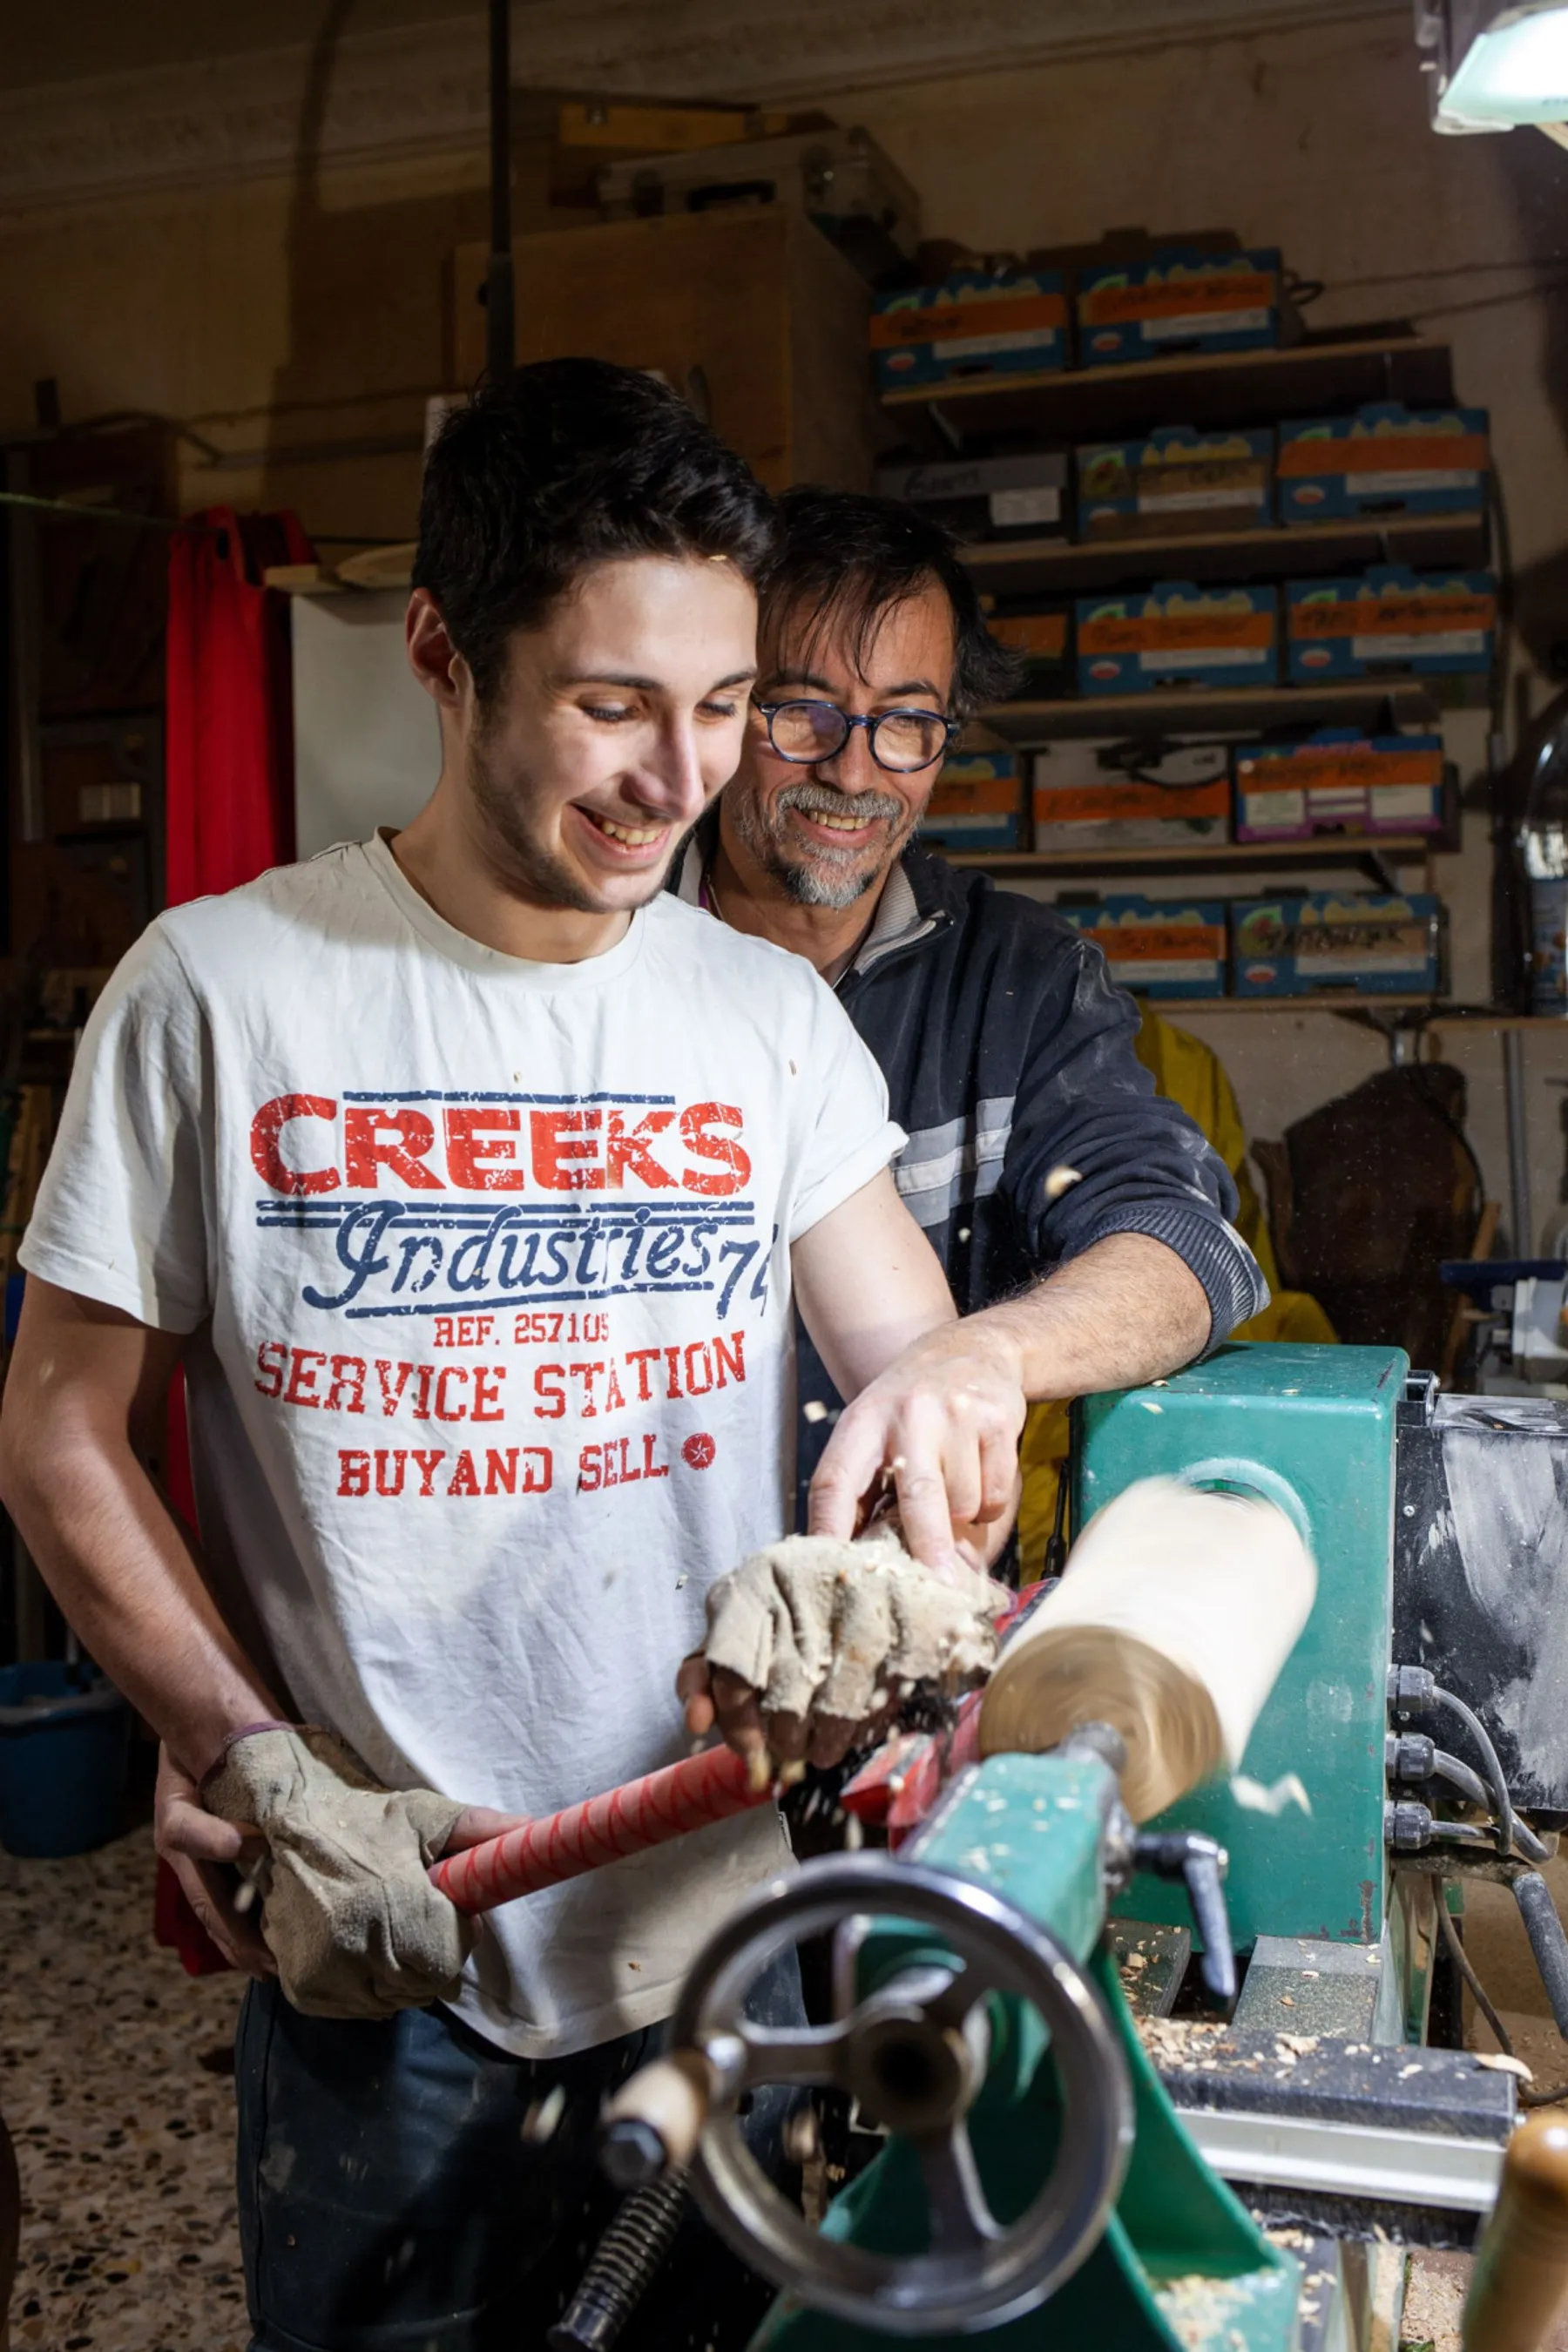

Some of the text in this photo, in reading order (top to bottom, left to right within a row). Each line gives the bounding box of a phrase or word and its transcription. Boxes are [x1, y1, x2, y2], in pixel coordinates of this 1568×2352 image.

[250, 1092, 752, 1195] CREEKS
[433, 1315, 500, 1347] REF.
[253, 1330, 747, 1422] SERVICE STATION
[578, 1433, 670, 1492] SELL
